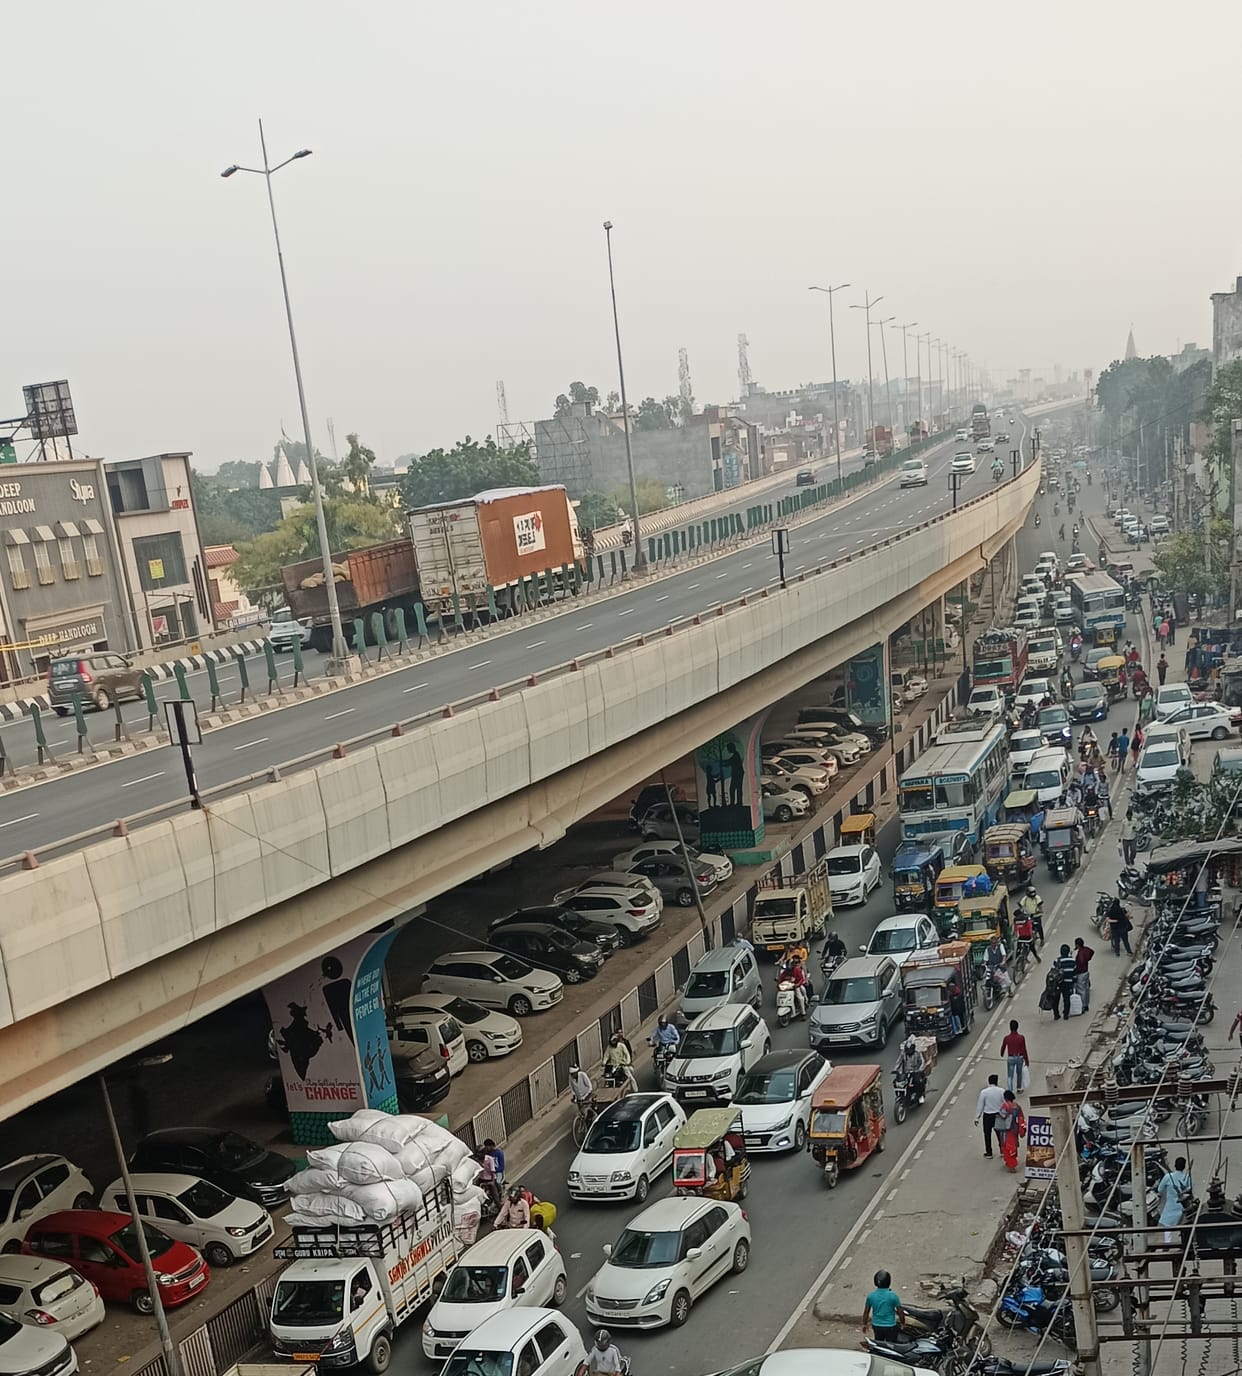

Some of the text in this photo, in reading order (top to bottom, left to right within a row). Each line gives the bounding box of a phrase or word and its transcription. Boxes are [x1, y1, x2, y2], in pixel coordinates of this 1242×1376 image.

[0, 498, 36, 516] NDLOOM
[59, 622, 98, 641] HANDLOOM
[355, 1001, 373, 1021] PEOPLE
[304, 1086, 358, 1101] CHANGE
[294, 1249, 334, 1257] GURU KRIPA
[409, 1238, 432, 1267] SHAWLS
